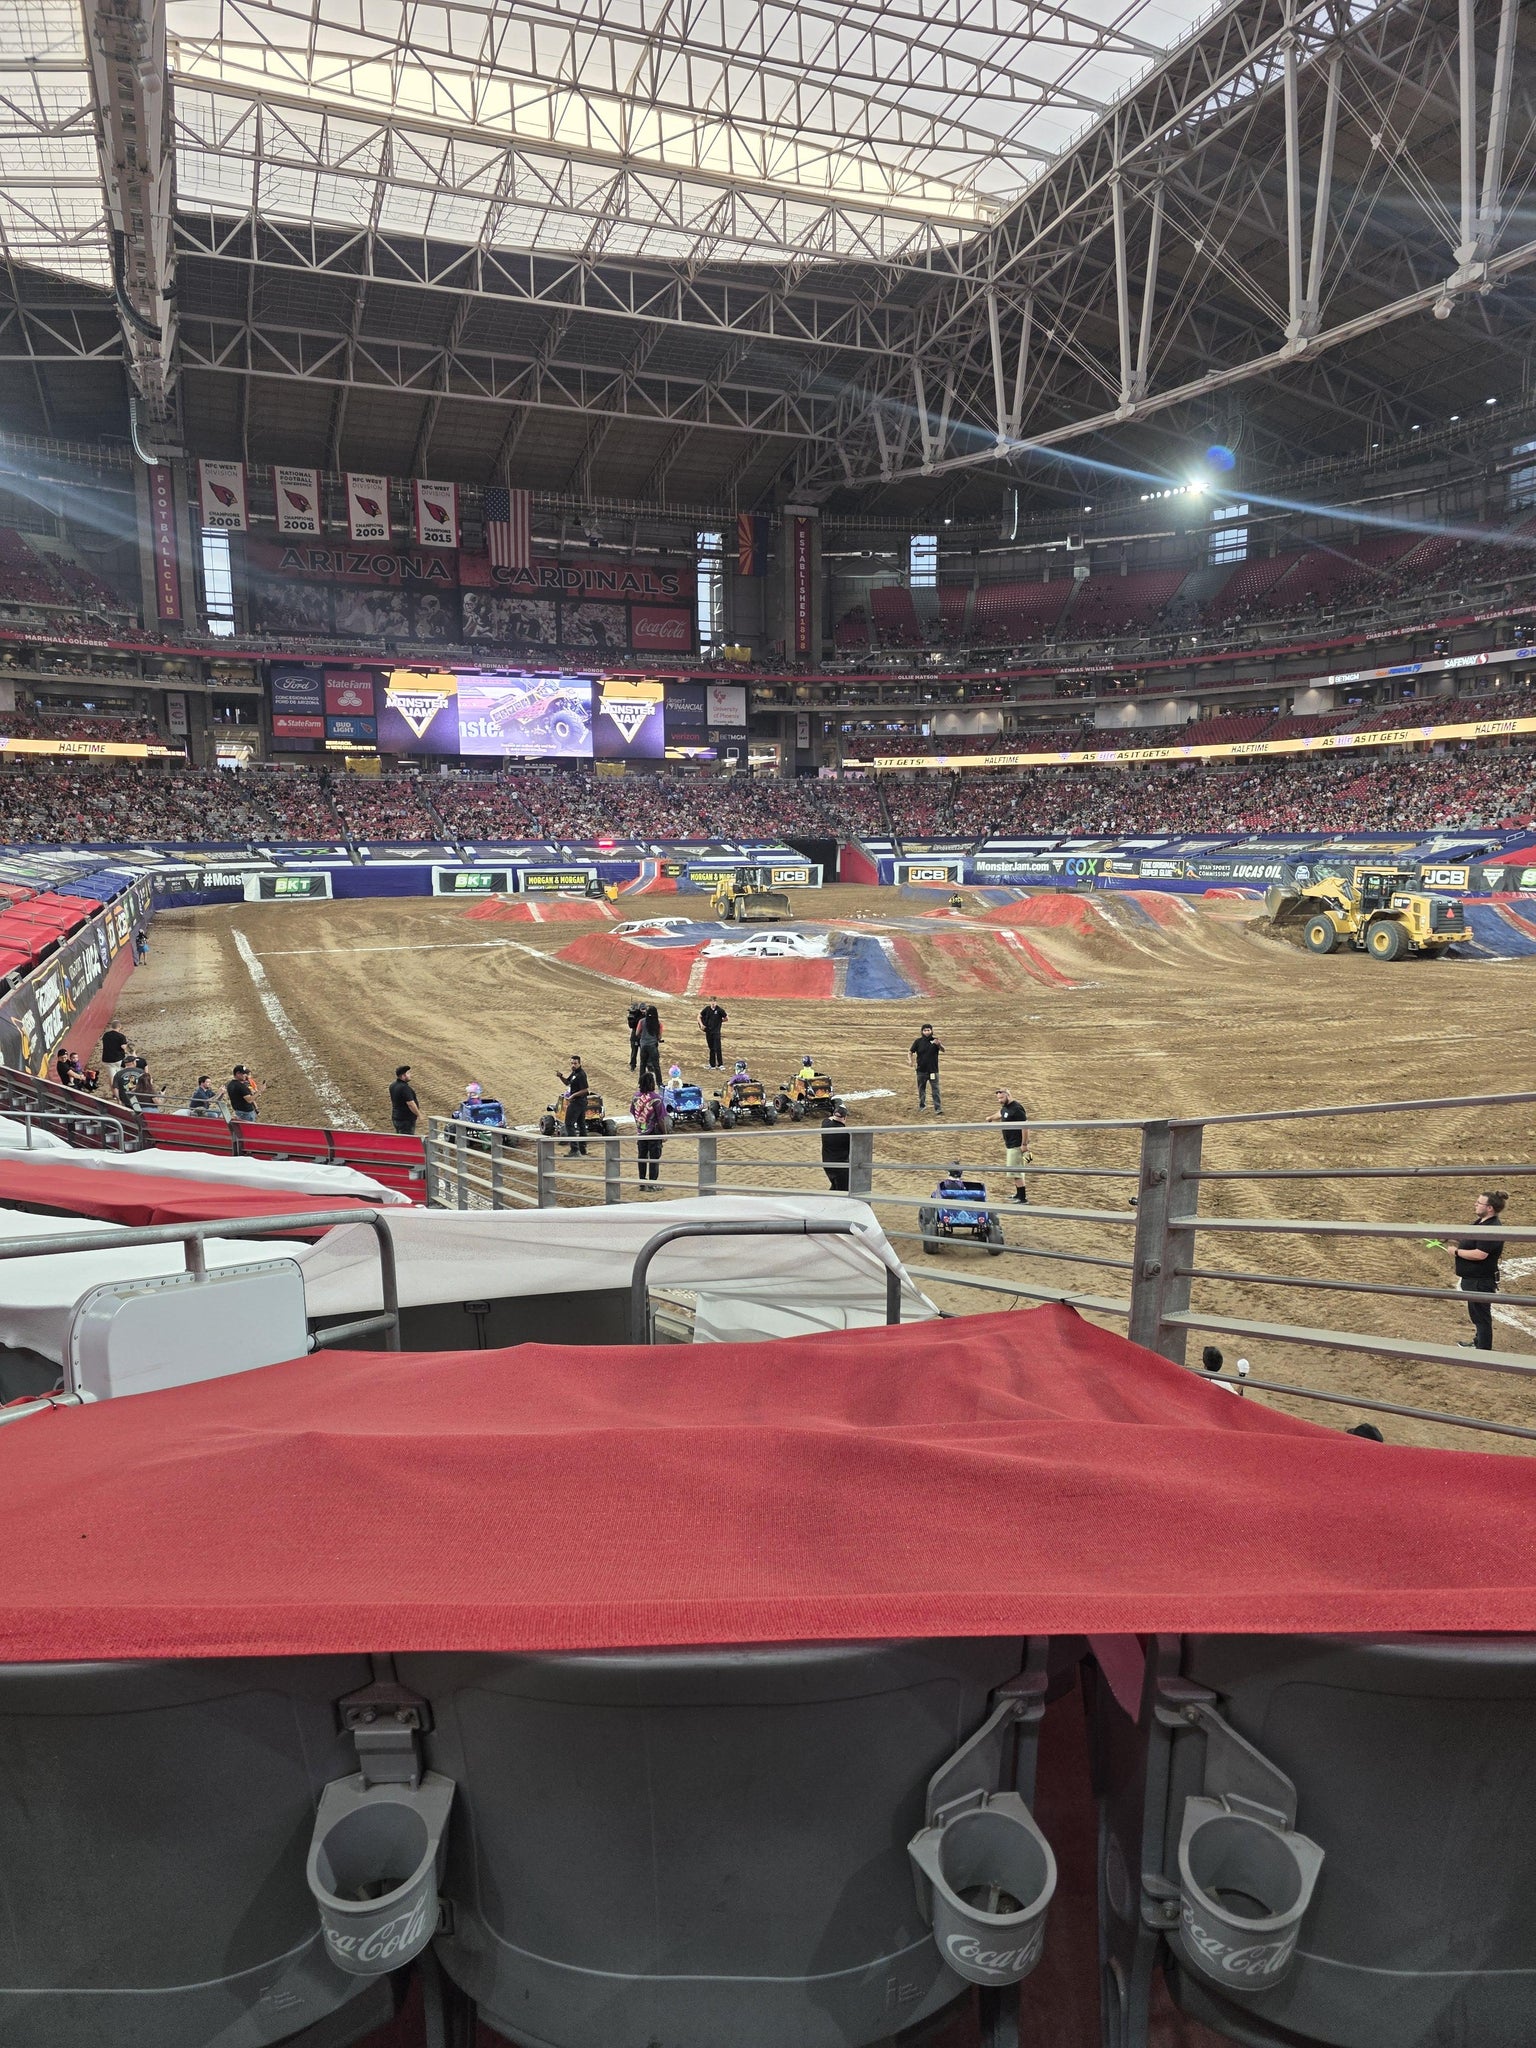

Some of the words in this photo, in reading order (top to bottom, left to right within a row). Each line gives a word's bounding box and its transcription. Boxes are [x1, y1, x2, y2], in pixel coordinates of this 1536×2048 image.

[352, 482, 382, 490] DIVISION
[157, 474, 170, 567] FOOTBALL
[208, 517, 241, 527] 2008
[284, 521, 315, 530] 2008
[355, 528, 385, 537] 2009
[424, 532, 452, 543] 2015
[279, 547, 453, 581] ARIZONA
[490, 566, 681, 595] CARDINALS
[164, 571, 174, 615] CLUB
[1474, 610, 1503, 621] WILLIAM
[24, 634, 67, 644] MARSHALL
[68, 637, 109, 647] GOLDBERG
[1366, 631, 1391, 640] CHARLES
[1444, 655, 1478, 669] SAFEWAY
[282, 677, 310, 690] Ford
[385, 698, 449, 709] MONSTER
[599, 703, 656, 716] MONSTER
[1474, 722, 1518, 734] HALFTIME
[671, 733, 700, 741] verizon
[1322, 738, 1334, 747] AS
[1354, 735, 1367, 744] AS
[1368, 734, 1378, 742] IT
[1380, 731, 1408, 741] GETS!
[59, 743, 106, 753] HALFTIME
[1231, 744, 1269, 754] HALFTIME
[984, 756, 1020, 764] HALFTIME
[1131, 751, 1140, 759] IT
[1142, 750, 1170, 758] GETS!
[896, 758, 924, 766] GETS!
[976, 860, 1050, 872] MonsterJam.com
[1065, 858, 1098, 876] COX
[690, 872, 713, 881] MORGAN
[774, 871, 806, 881] JCB
[911, 871, 946, 880] JCB
[1232, 864, 1264, 879] LUCAS
[1264, 866, 1282, 880] OIL
[1424, 870, 1465, 885] JCB
[275, 878, 311, 892] BKT
[455, 873, 492, 888] BKT
[528, 876, 553, 885] MORGAN
[554, 876, 559, 884] &
[560, 876, 585, 884] MORGAN
